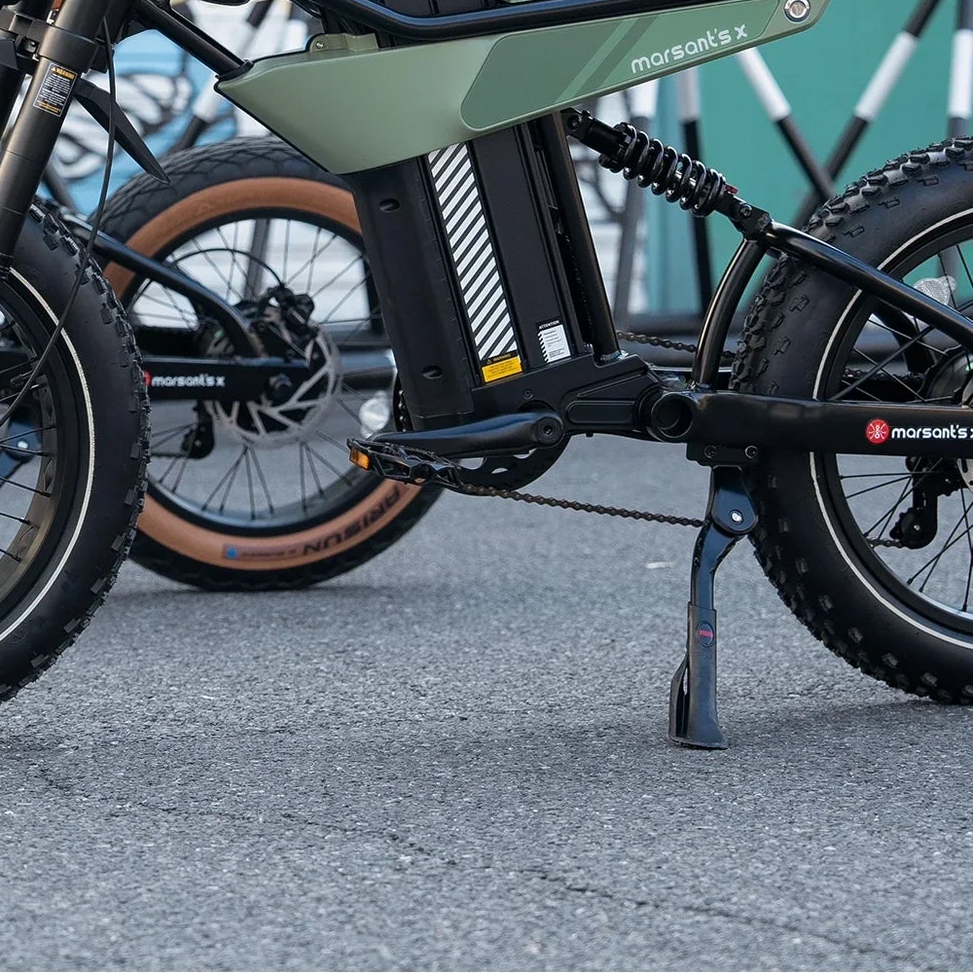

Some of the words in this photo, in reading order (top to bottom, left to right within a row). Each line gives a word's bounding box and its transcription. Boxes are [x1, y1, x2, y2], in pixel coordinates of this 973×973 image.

[630, 28, 732, 74] marsant's
[734, 24, 748, 40] x
[891, 424, 968, 439] marsant's
